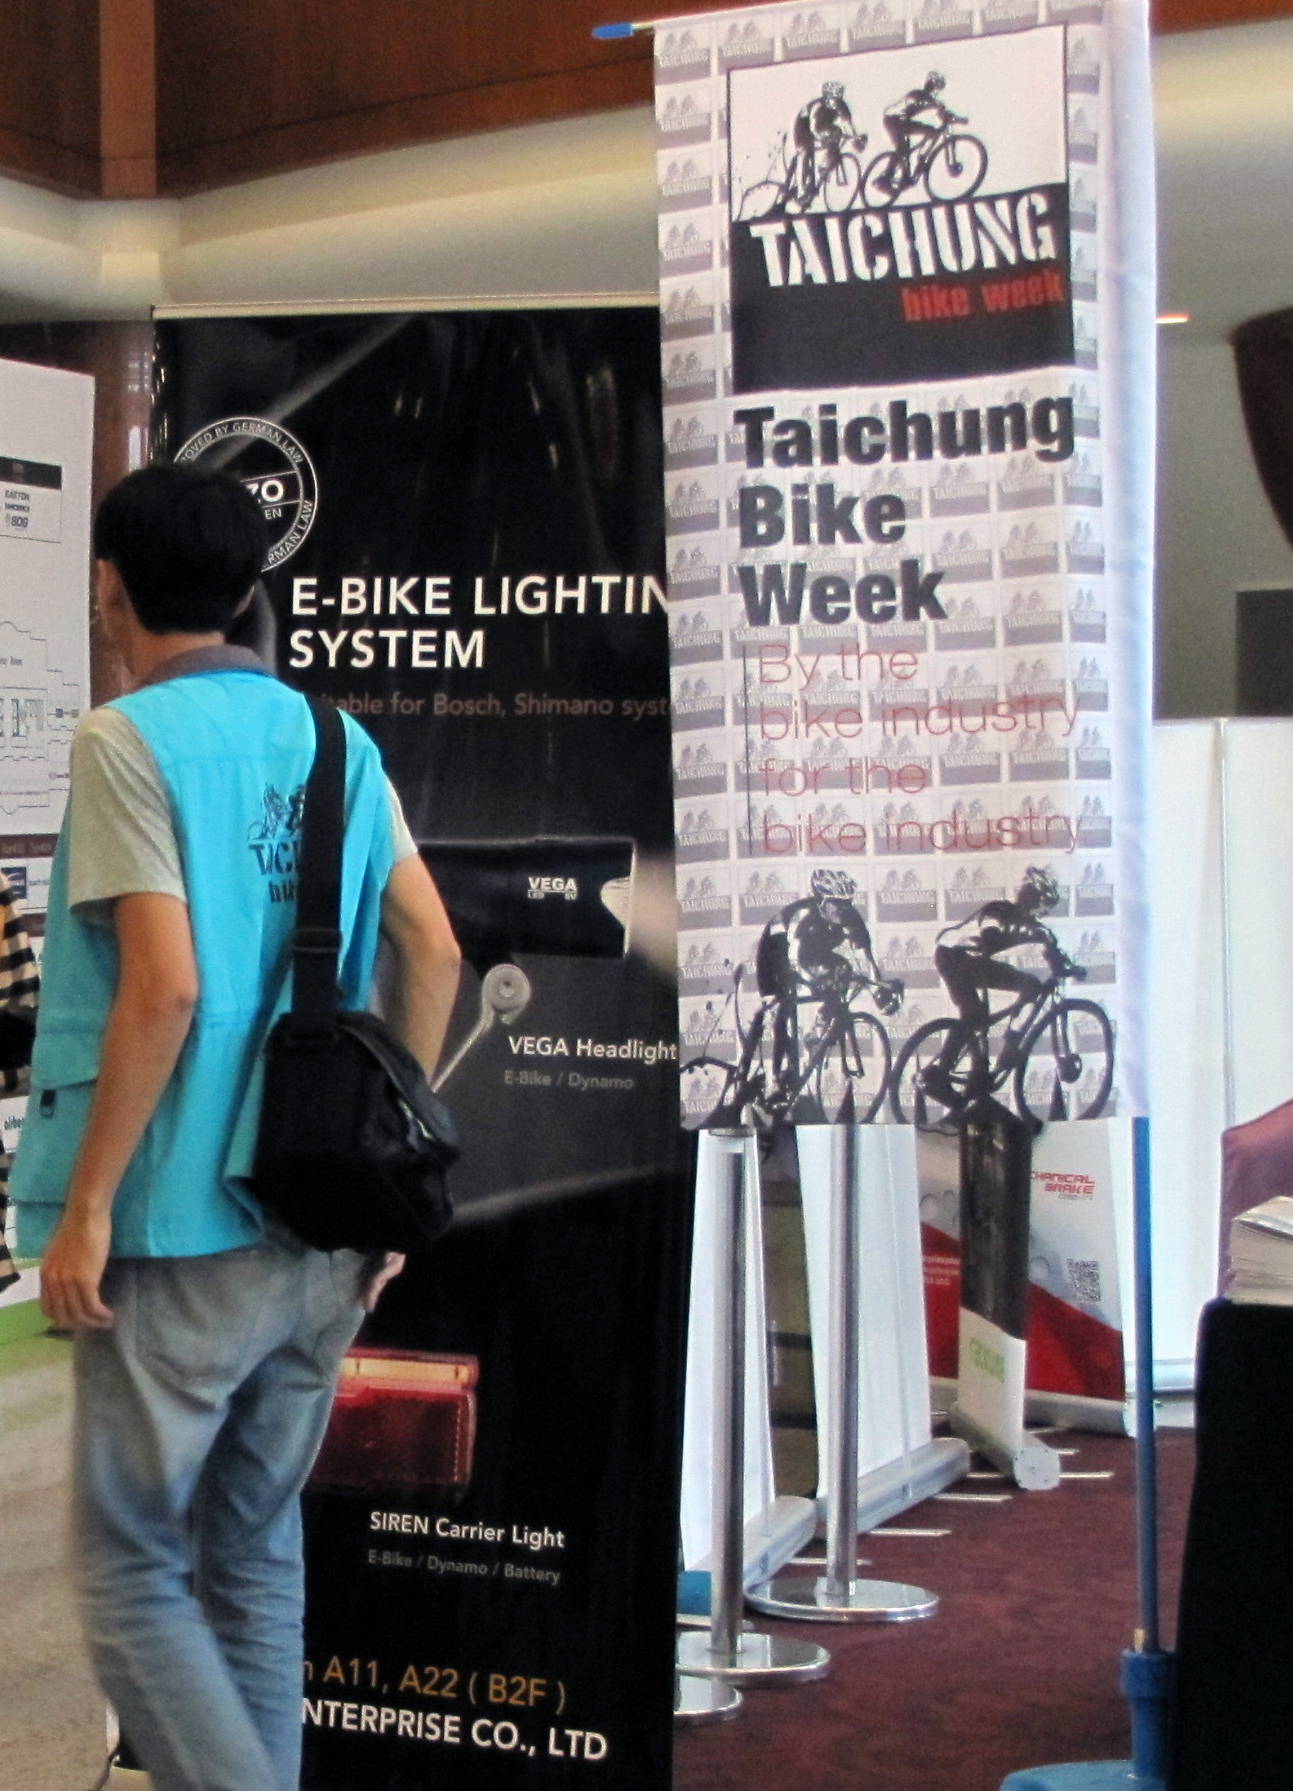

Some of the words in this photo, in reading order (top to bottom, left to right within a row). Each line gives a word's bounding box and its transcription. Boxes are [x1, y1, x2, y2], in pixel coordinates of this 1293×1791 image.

[749, 192, 1057, 287] TAICHUNG
[901, 284, 972, 322] bike
[982, 269, 1064, 313] week
[215, 425, 229, 437] BY
[232, 422, 282, 442] GERMAN
[282, 439, 304, 464] LAW
[733, 396, 1075, 470] Taichung
[298, 500, 313, 530] LAW
[738, 482, 906, 549] Bike
[291, 577, 451, 616] E-BIKE
[738, 559, 948, 628] Week
[289, 629, 485, 669] SYSTEM
[757, 644, 824, 691] By
[835, 642, 918, 680] the
[390, 692, 425, 715] for
[433, 693, 505, 719] Bosch,
[514, 693, 611, 716] Shimano
[759, 700, 864, 741] bike
[882, 692, 1080, 738] industry
[759, 758, 832, 797] for
[848, 755, 927, 795] the
[764, 813, 867, 854] bike
[885, 809, 1082, 854] industry
[528, 877, 577, 891] VEGA
[509, 1036, 569, 1056] VEGA
[577, 1038, 678, 1065] Headlight
[505, 1070, 551, 1085] E-Bike
[568, 1072, 634, 1090] Dynamo
[1045, 1183, 1095, 1194] BRAKE
[370, 1511, 429, 1535] SIREN
[436, 1518, 505, 1542] Carrier
[512, 1525, 565, 1551] Light
[368, 1550, 413, 1567] E-Bike
[427, 1555, 488, 1577] Dynamo
[505, 1563, 561, 1586] Battery
[323, 1656, 388, 1694] A11,
[399, 1665, 458, 1698] A22
[488, 1674, 548, 1707] B2F
[471, 1719, 536, 1756] CO.,
[548, 1727, 607, 1761] LTD
